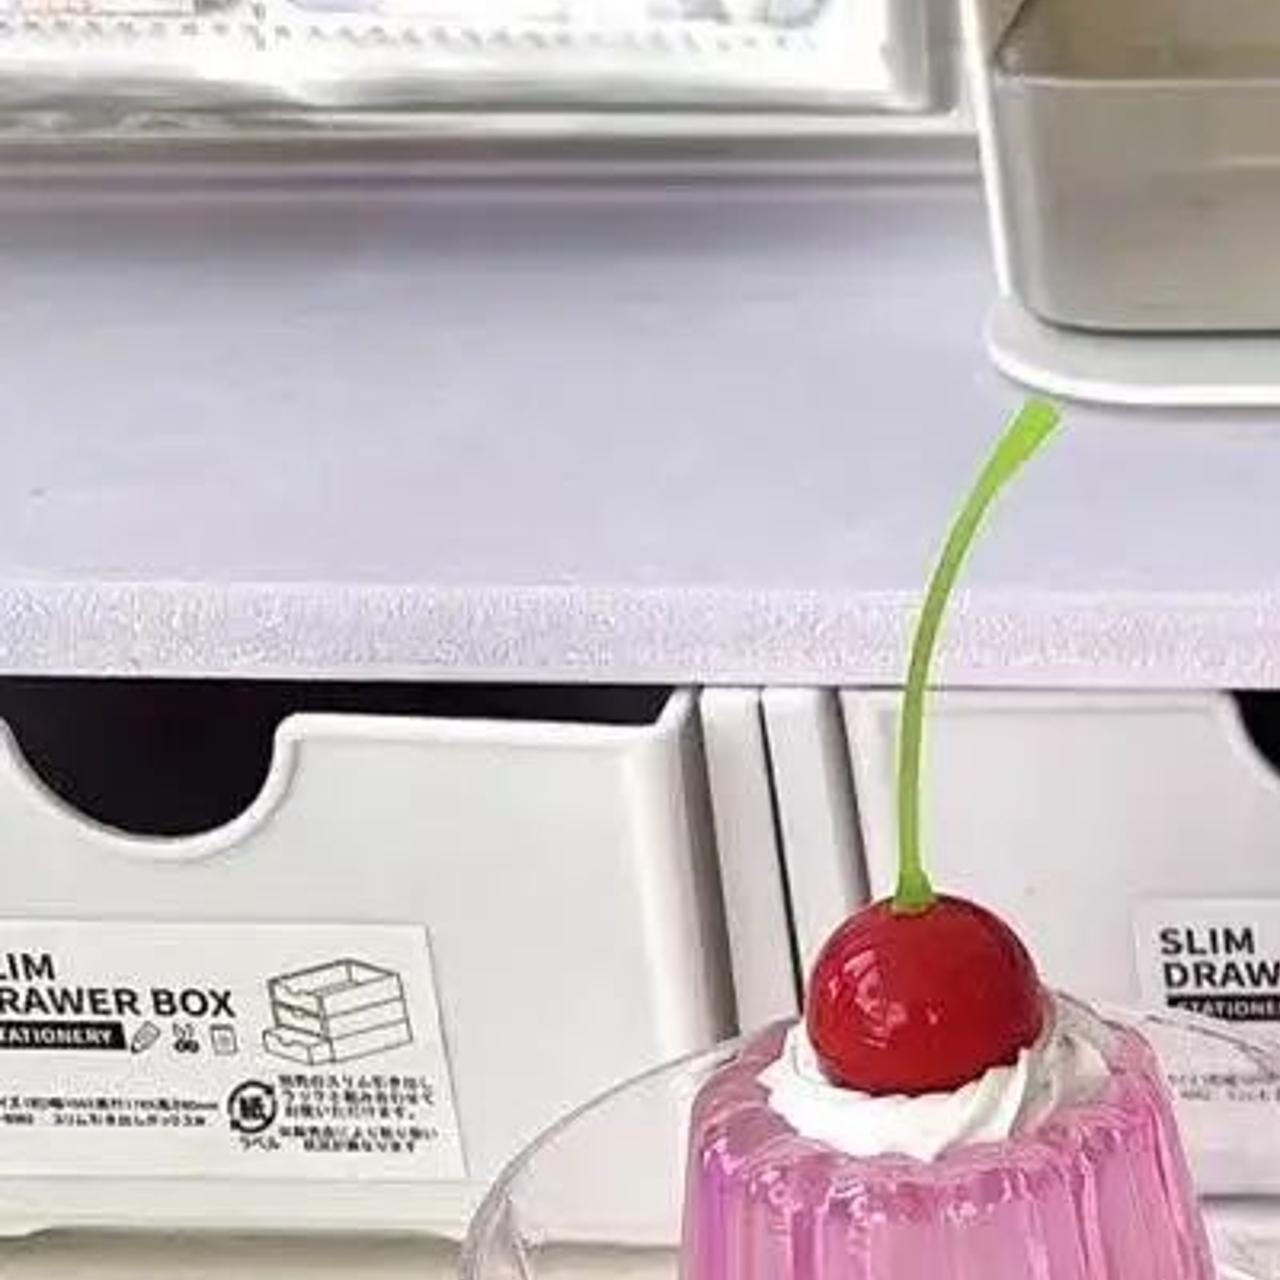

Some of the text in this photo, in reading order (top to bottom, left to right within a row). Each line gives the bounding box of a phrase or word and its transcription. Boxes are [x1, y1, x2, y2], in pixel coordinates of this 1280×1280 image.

[1160, 928, 1255, 955] SLIM
[0, 987, 236, 1018] RAWER BOX
